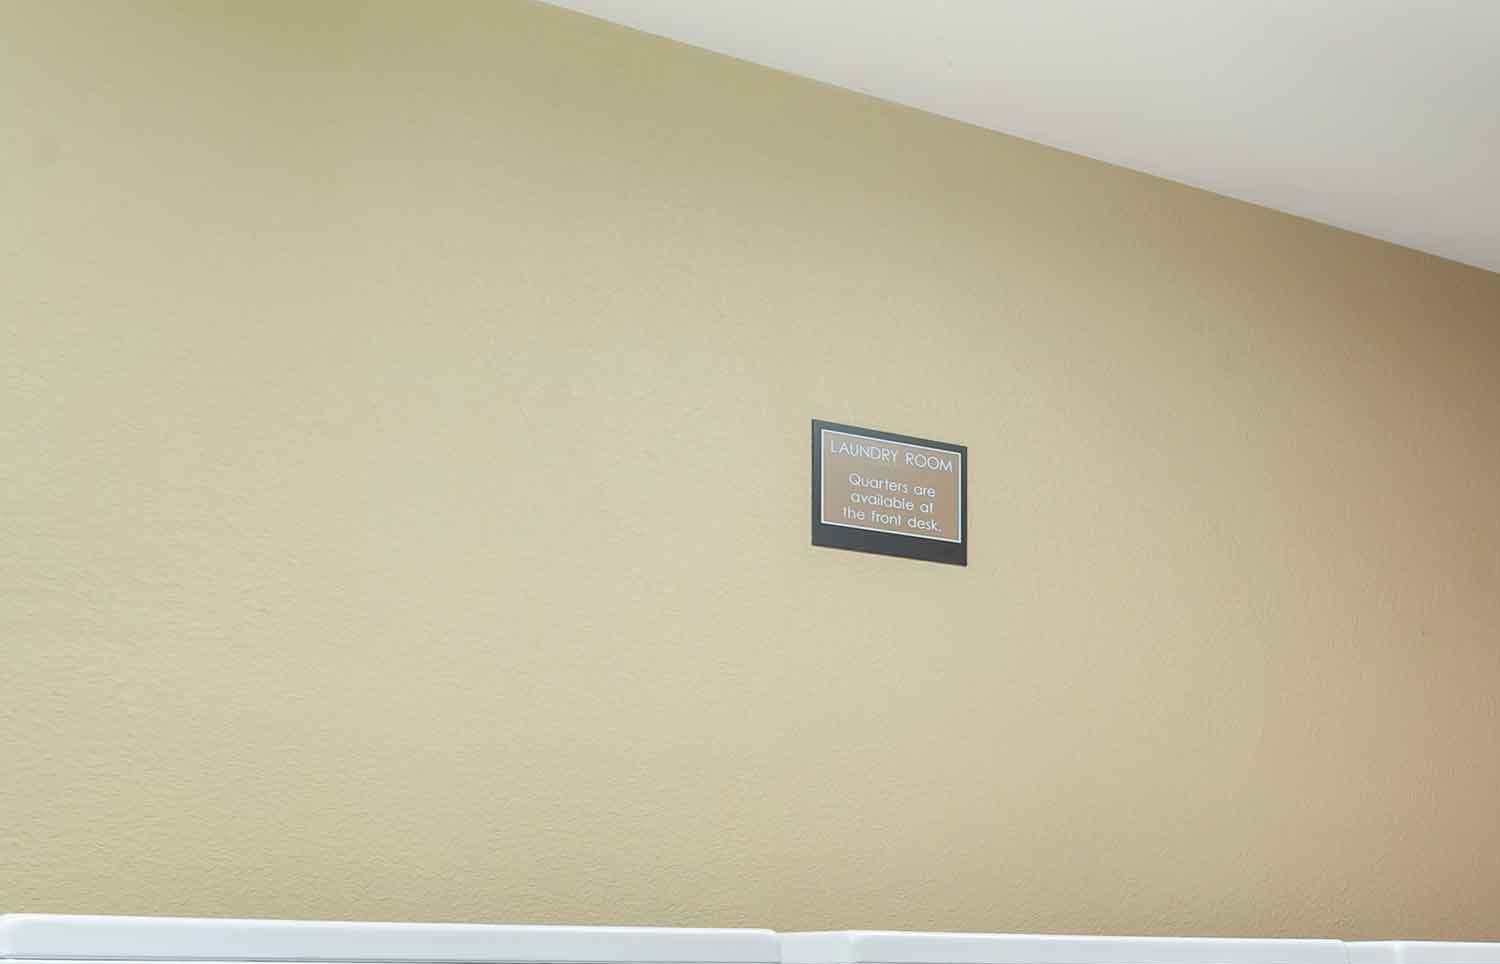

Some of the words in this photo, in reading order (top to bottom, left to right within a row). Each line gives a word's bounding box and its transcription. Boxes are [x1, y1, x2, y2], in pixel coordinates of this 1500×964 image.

[830, 439, 898, 464] LAUNDRY
[905, 452, 953, 472] ROOM
[848, 472, 908, 493] Quarters
[913, 486, 936, 497] are
[850, 492, 914, 511] available
[919, 502, 934, 513] at
[843, 506, 865, 520] the
[871, 510, 902, 526] front
